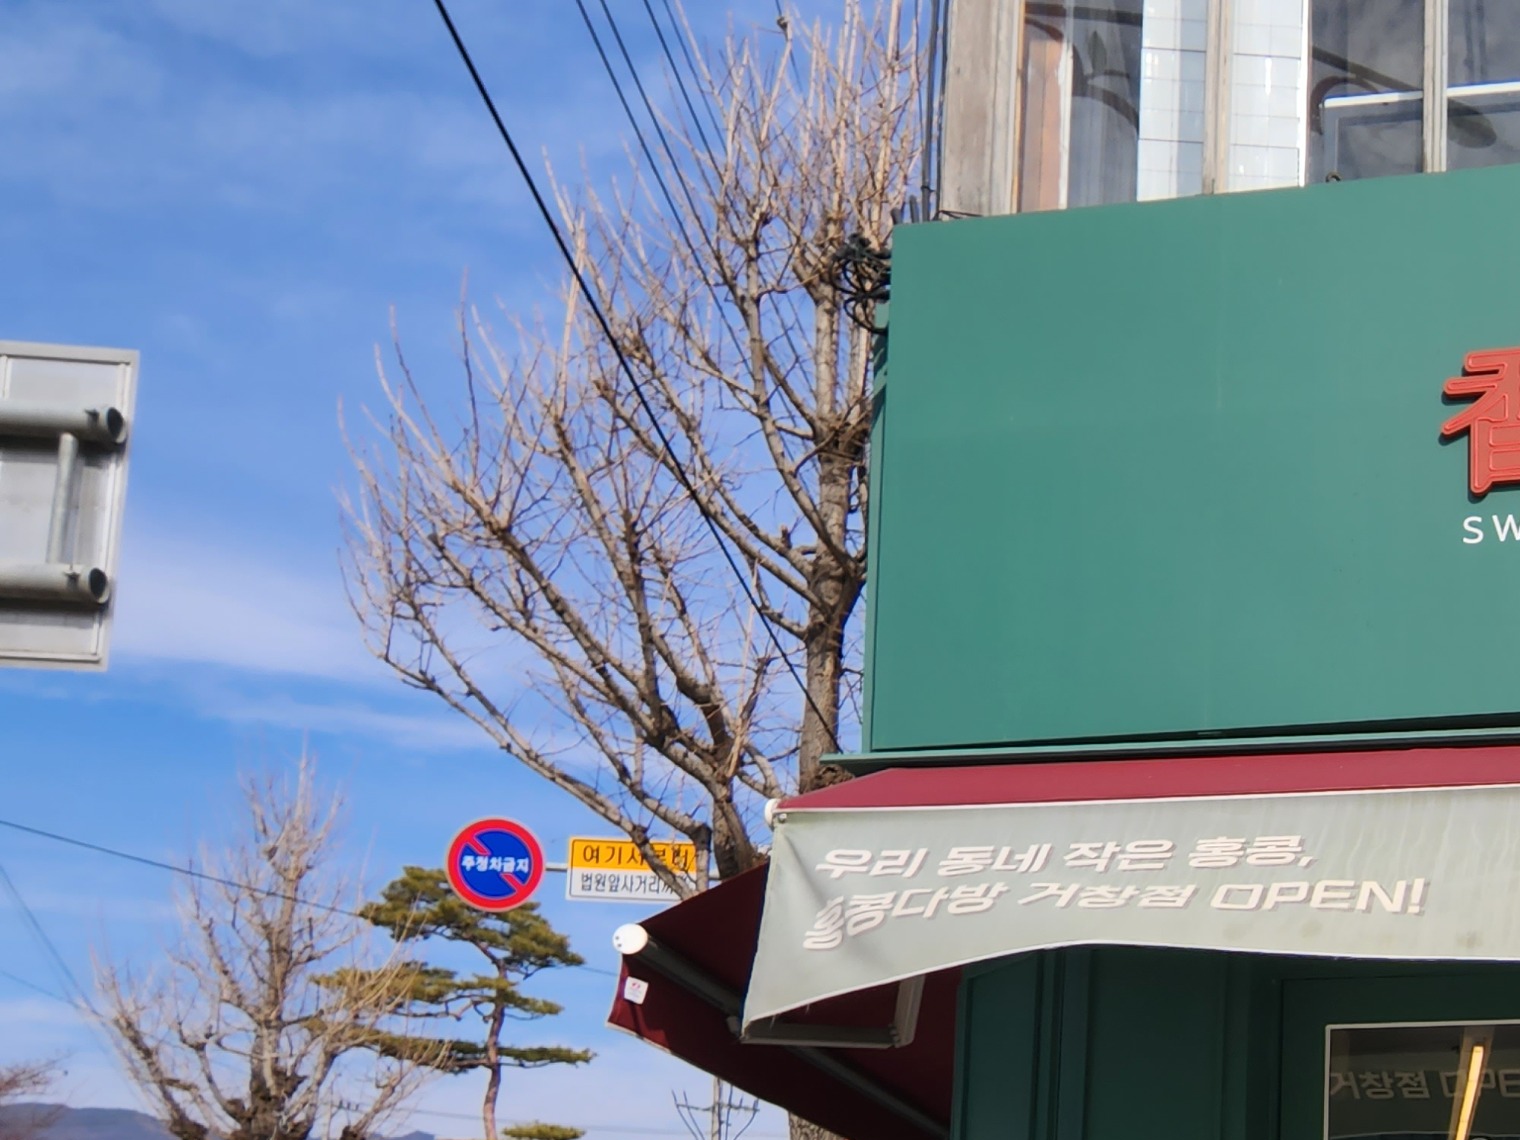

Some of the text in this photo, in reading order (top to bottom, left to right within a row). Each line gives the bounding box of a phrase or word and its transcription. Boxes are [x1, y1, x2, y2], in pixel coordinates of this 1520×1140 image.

[462, 855, 529, 873] 주정차금지
[816, 835, 1317, 880] 우리 동네 작은 홍콩,
[581, 872, 688, 895] 법원앞사거리
[803, 878, 1426, 949] 홍콩다방 거창점 OPEN!
